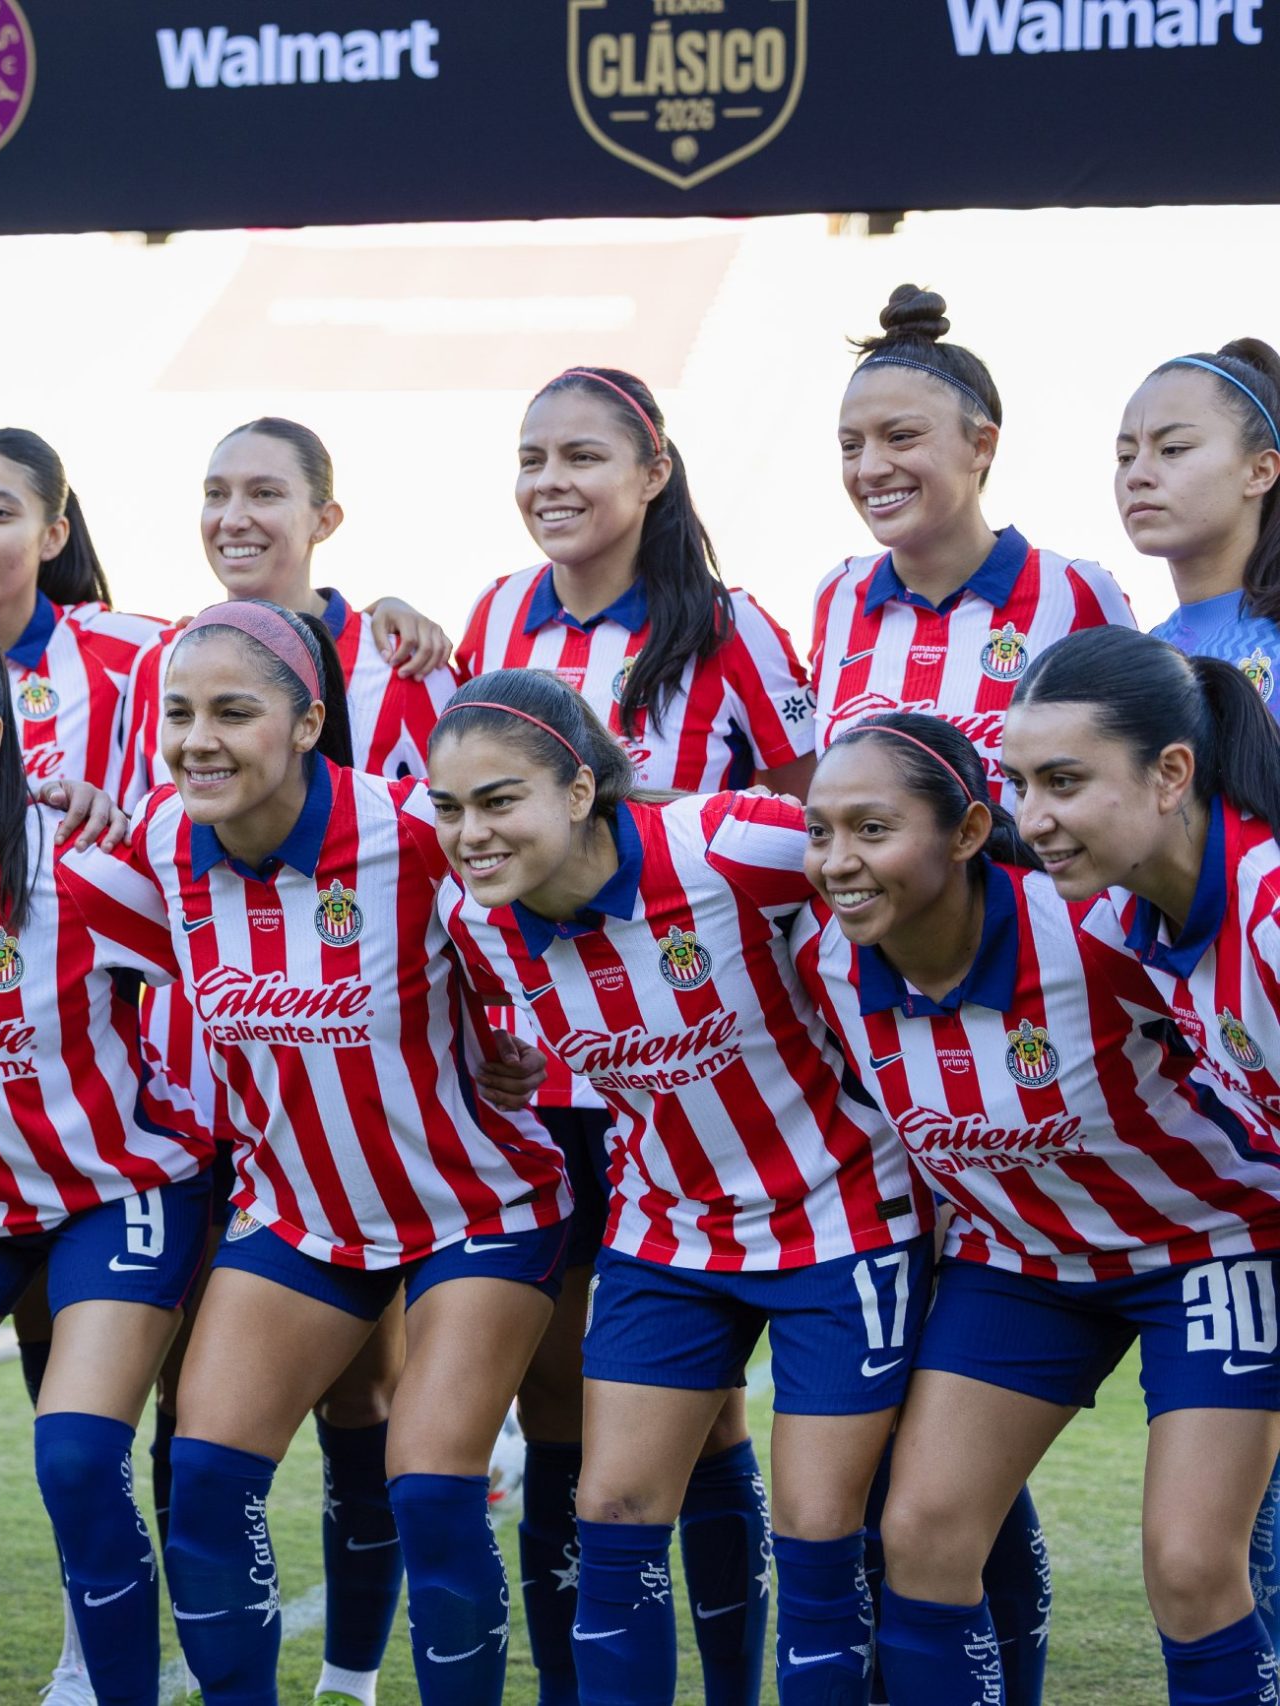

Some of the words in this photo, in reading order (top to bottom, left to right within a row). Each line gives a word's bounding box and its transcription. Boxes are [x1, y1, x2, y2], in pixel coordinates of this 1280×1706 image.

[156, 19, 440, 89] Walmart
[947, 0, 1263, 56] Walmart
[586, 20, 786, 97] CLÁSICO
[655, 97, 716, 132] 2026
[247, 908, 284, 917] amazon
[252, 916, 280, 927] prime
[192, 964, 372, 1023] Caliente
[588, 964, 626, 979] amazon
[595, 973, 624, 988] prime
[214, 1020, 372, 1045] caliente.mx
[557, 1006, 738, 1075] Caliente
[936, 1048, 972, 1059] amazon
[942, 1057, 970, 1068] prime
[891, 1105, 1082, 1155] Caliente
[123, 1186, 165, 1259] 9
[852, 1250, 910, 1350] 17
[1182, 1260, 1278, 1354] 30
[245, 1521, 277, 1585] Carl's
